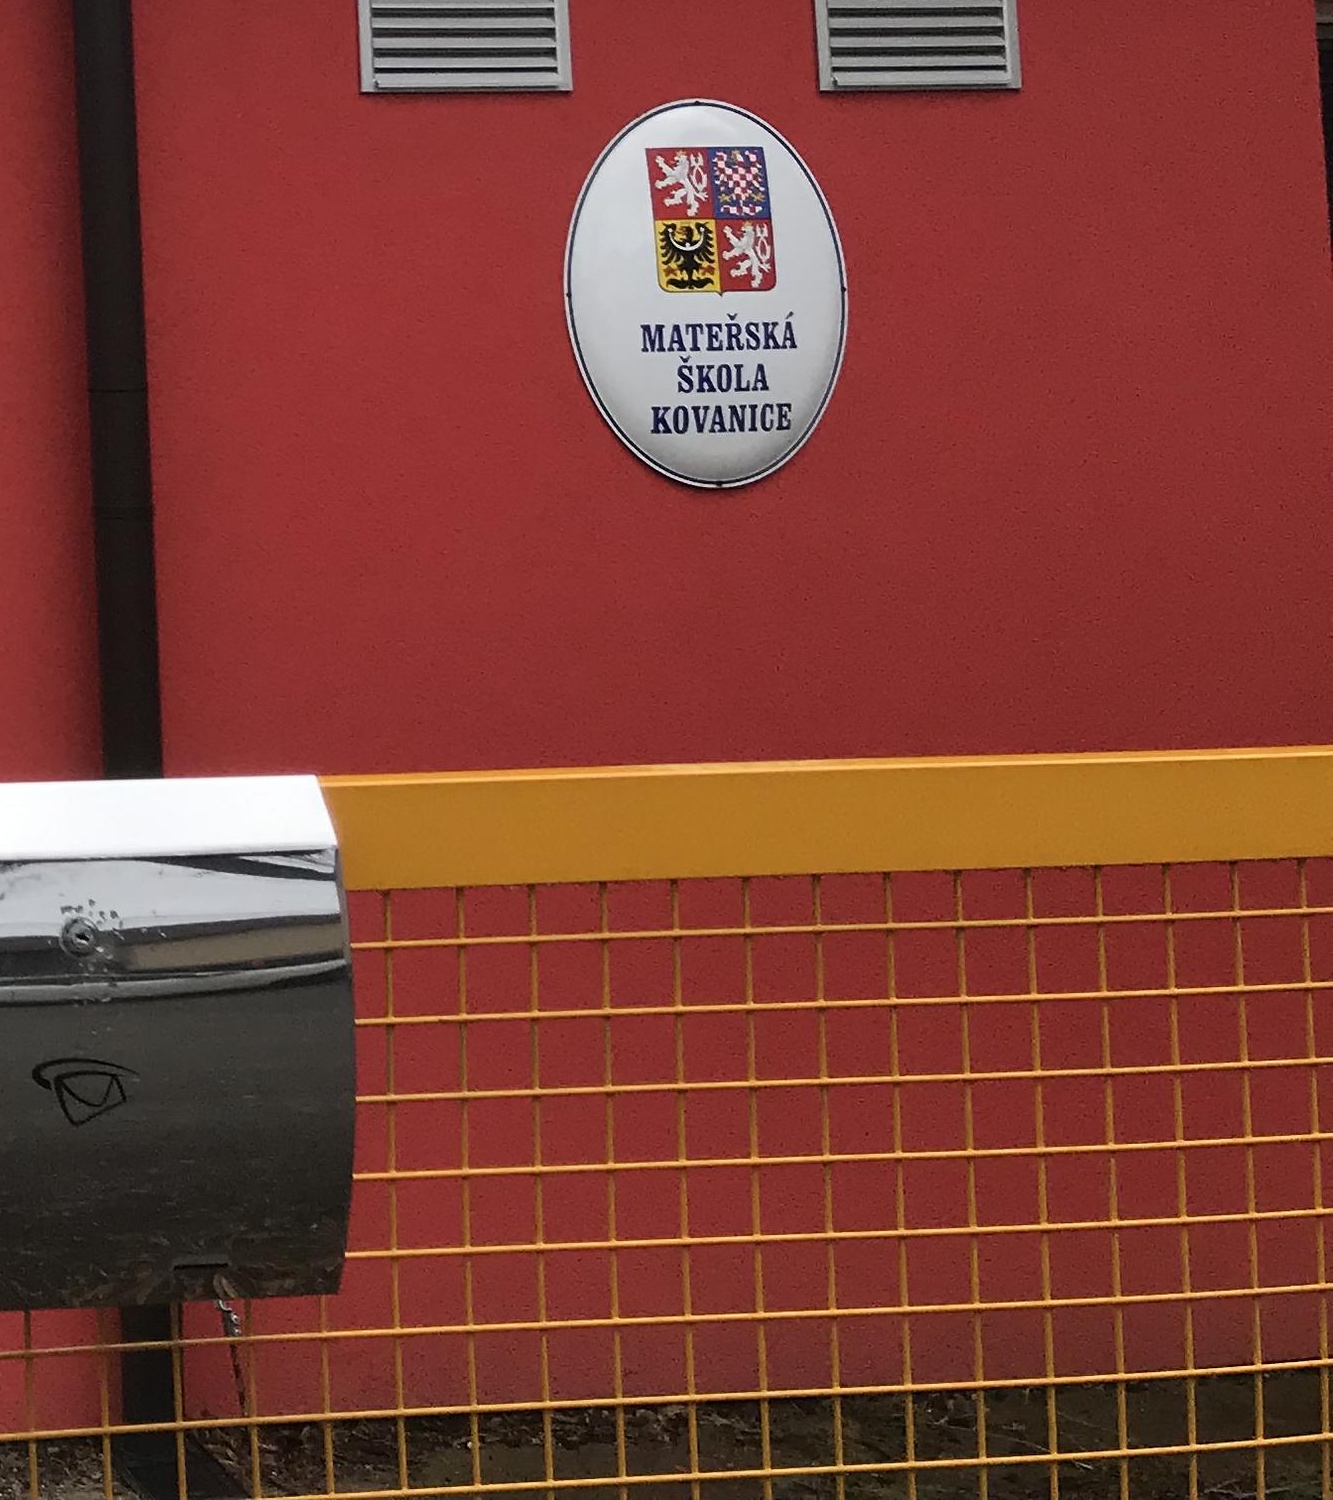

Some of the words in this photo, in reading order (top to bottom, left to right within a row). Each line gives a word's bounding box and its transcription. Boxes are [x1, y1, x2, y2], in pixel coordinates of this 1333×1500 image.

[640, 311, 797, 352] MATEŘSKÁ
[677, 355, 769, 393] ŠKOLA
[650, 403, 792, 434] KOVANICE
